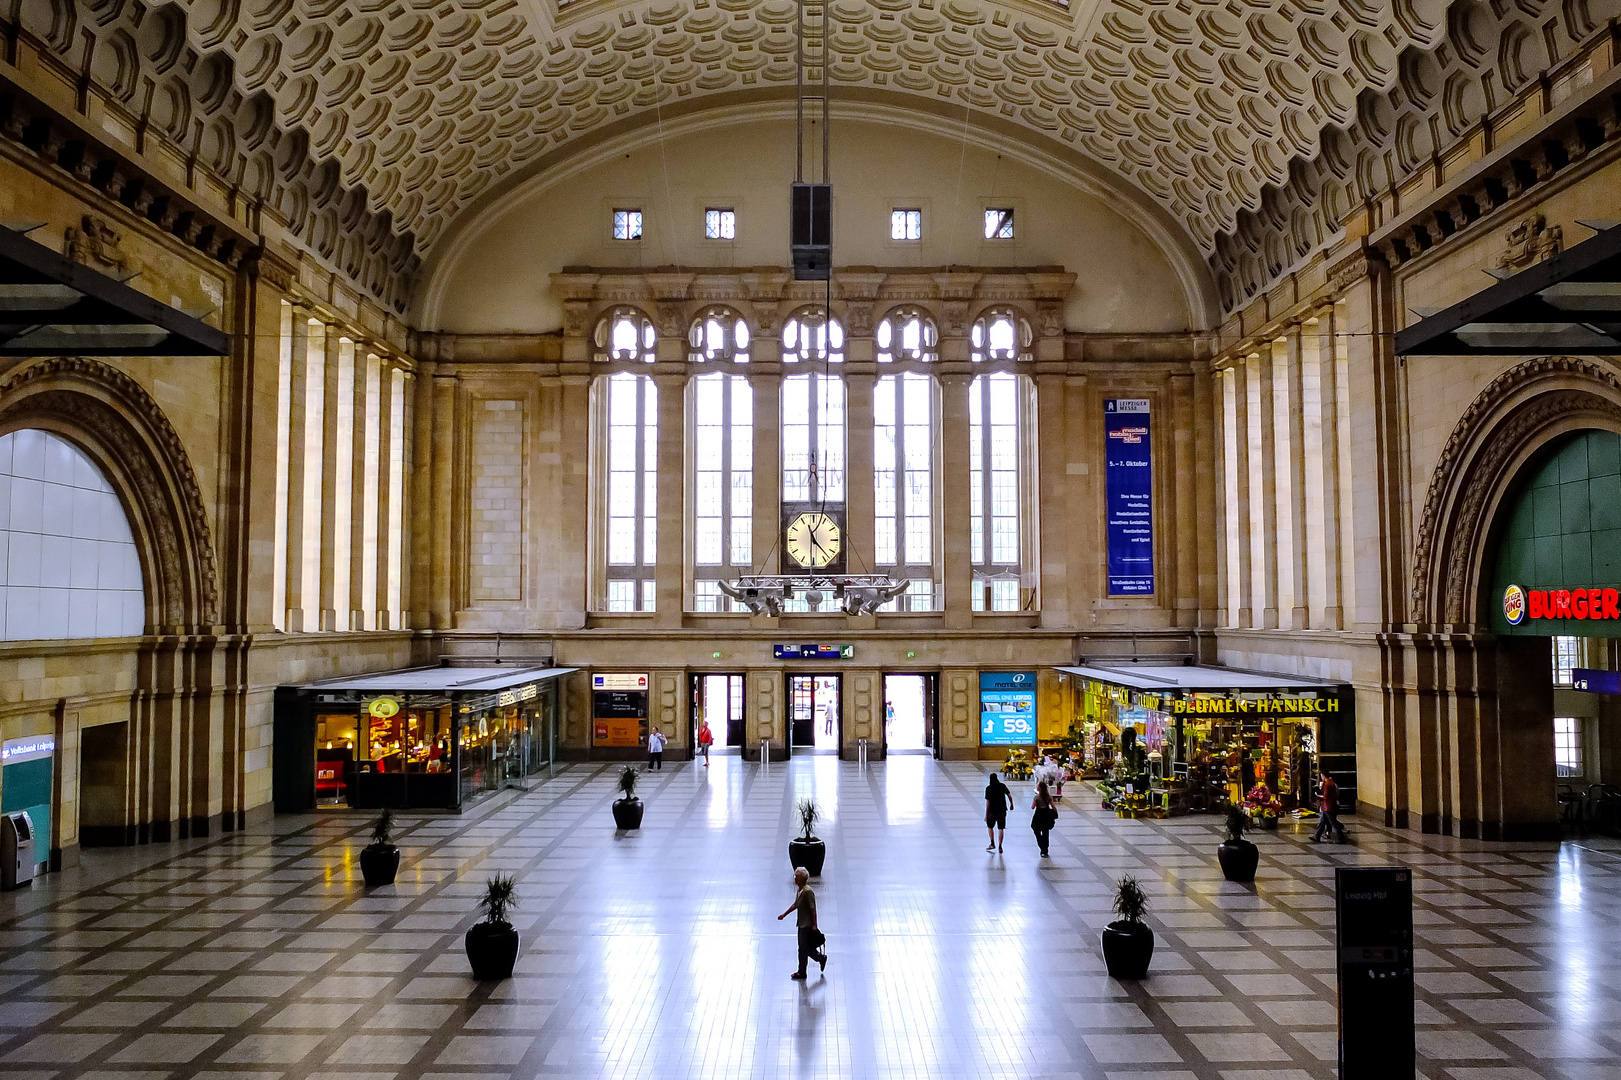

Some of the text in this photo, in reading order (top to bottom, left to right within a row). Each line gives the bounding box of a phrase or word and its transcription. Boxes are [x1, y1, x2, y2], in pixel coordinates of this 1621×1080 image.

[1528, 588, 1620, 620] BURGER
[1173, 698, 1339, 714] BLUMEN-HANISCH
[10, 743, 37, 755] Volksbank
[1345, 891, 1387, 900] Leipzig Hbf
